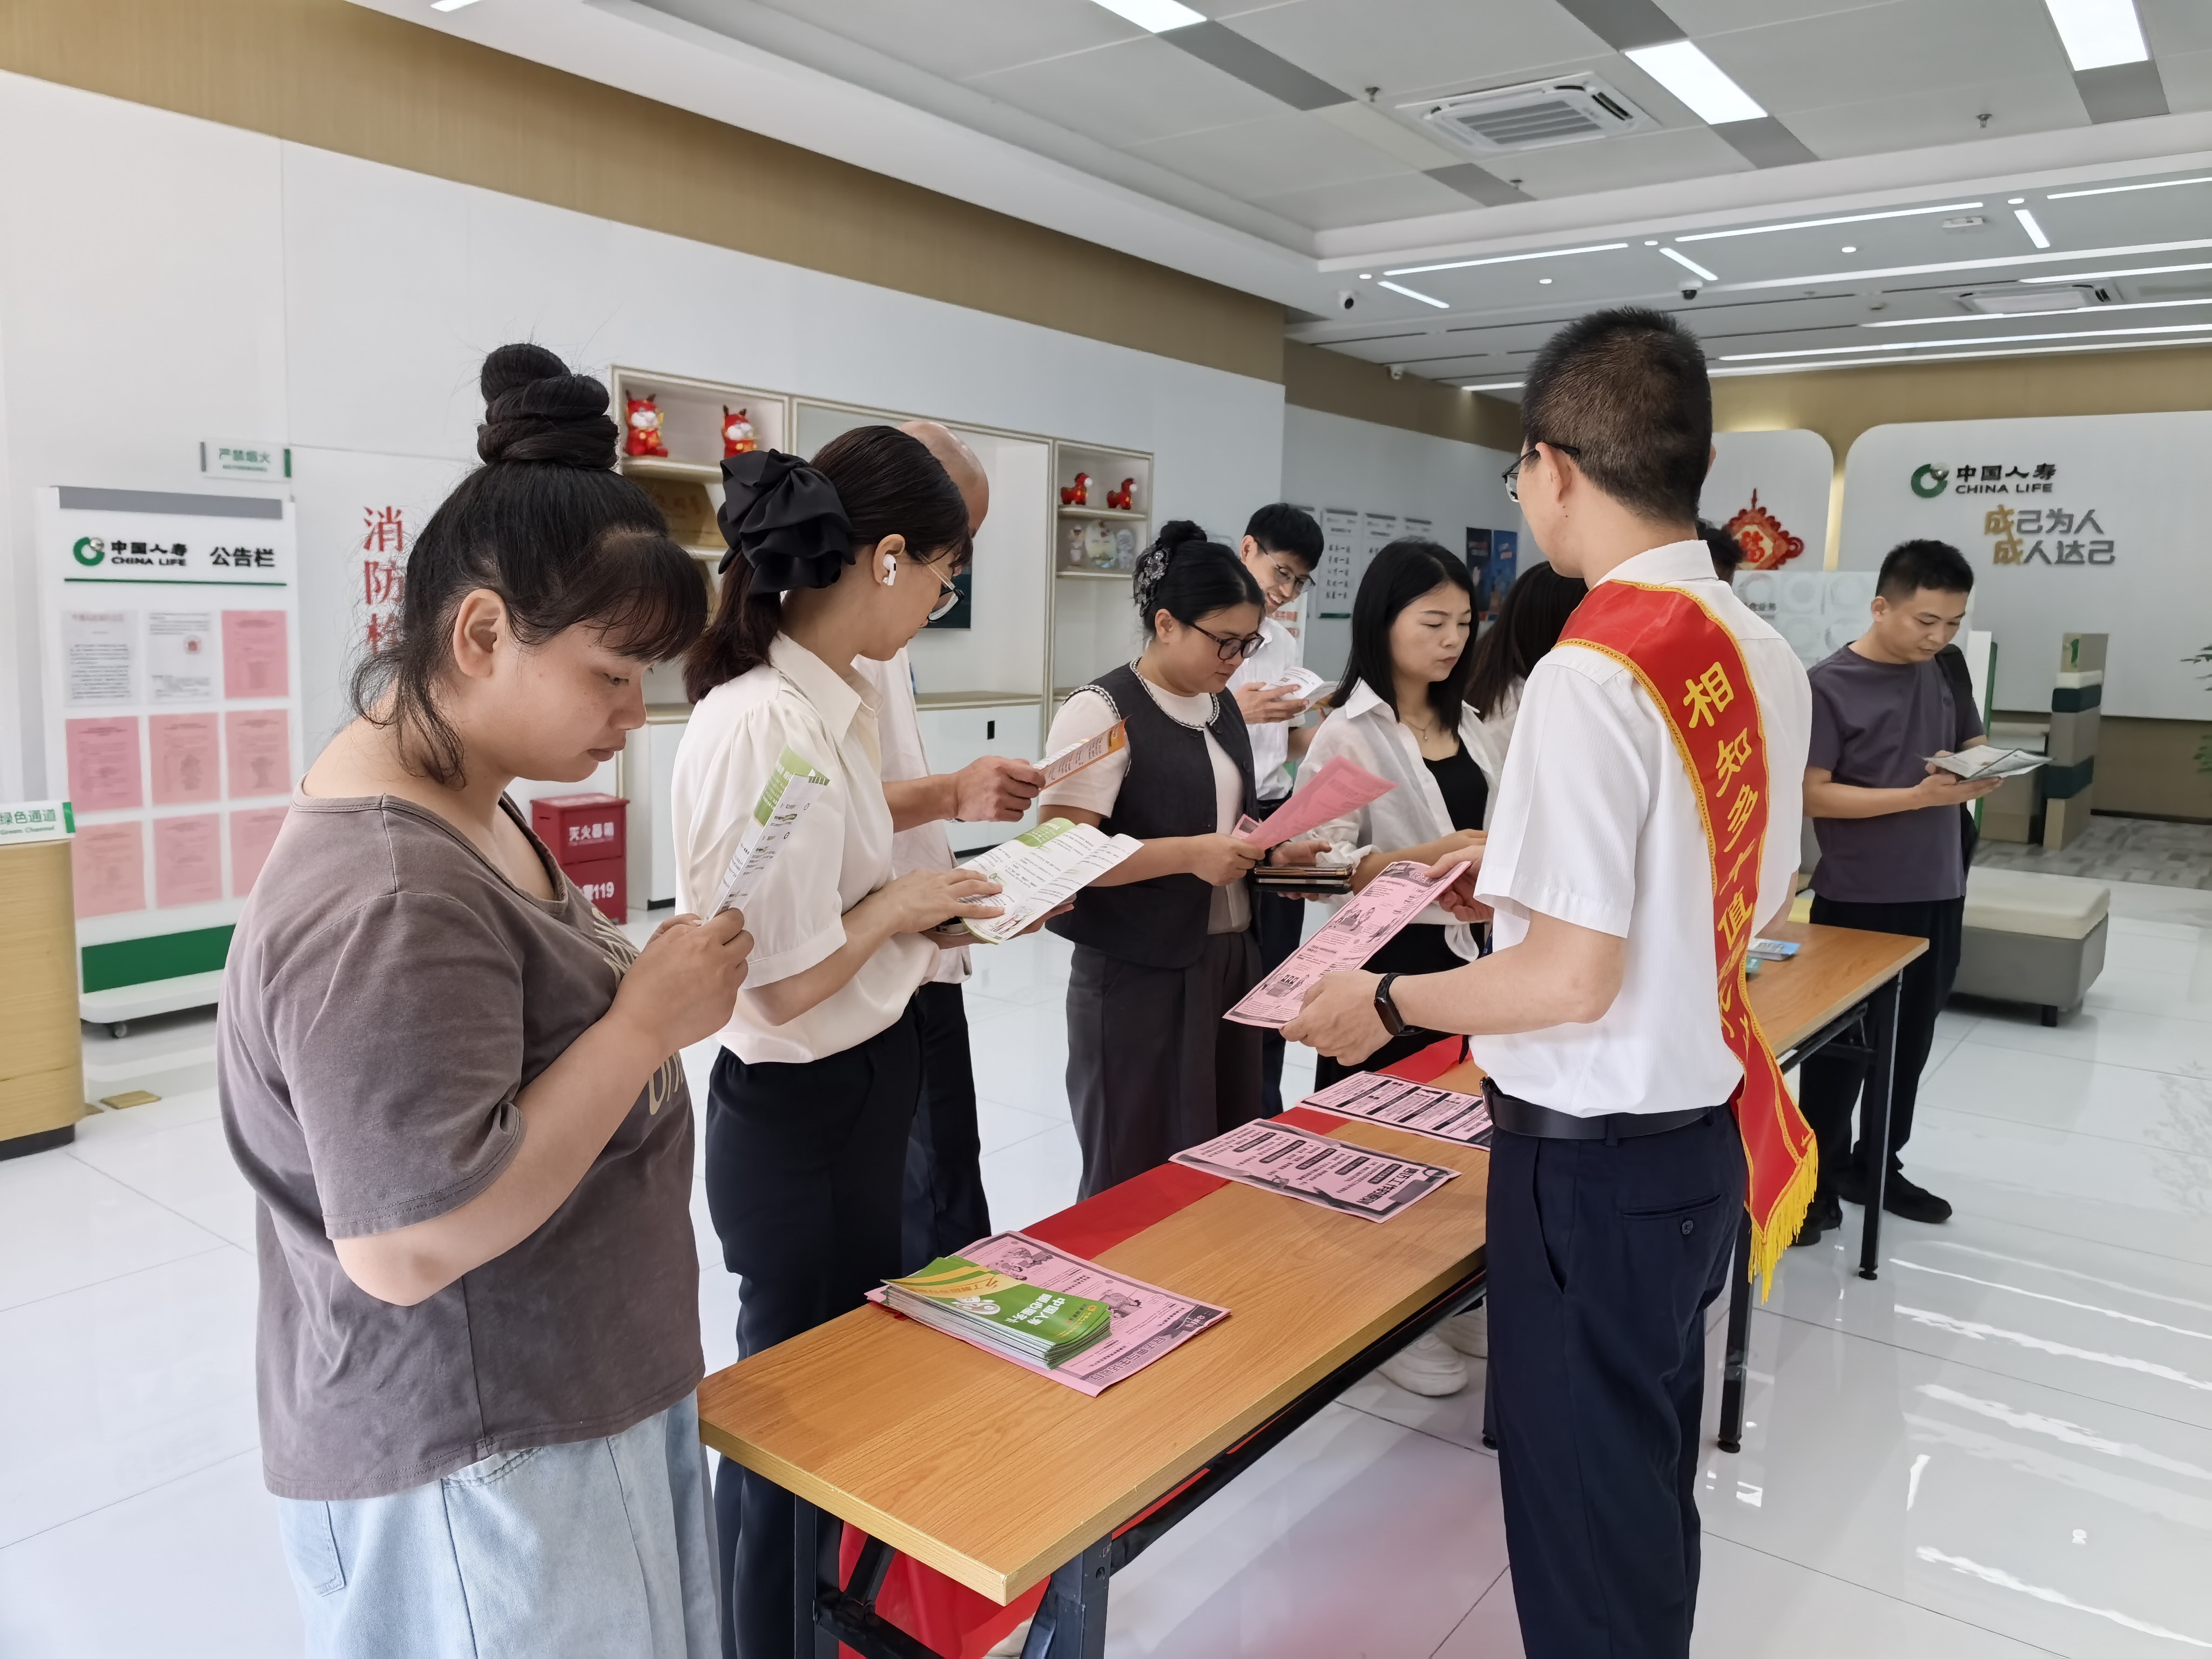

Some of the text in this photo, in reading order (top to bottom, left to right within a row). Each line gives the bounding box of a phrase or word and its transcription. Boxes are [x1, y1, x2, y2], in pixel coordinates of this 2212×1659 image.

[1956, 462, 2056, 483] 中国人寿
[1955, 483, 2053, 494] CHINA LIFE
[1984, 504, 2105, 536] 成己为人
[111, 540, 187, 556] 中国人寿
[210, 547, 275, 568] 公告栏
[1993, 538, 2116, 565] 成人达己
[111, 556, 186, 566] CHINA LIFE
[1027, 1297, 1066, 1325] 中国人寿
[1089, 1336, 1166, 1381] 民法典与生活同行
